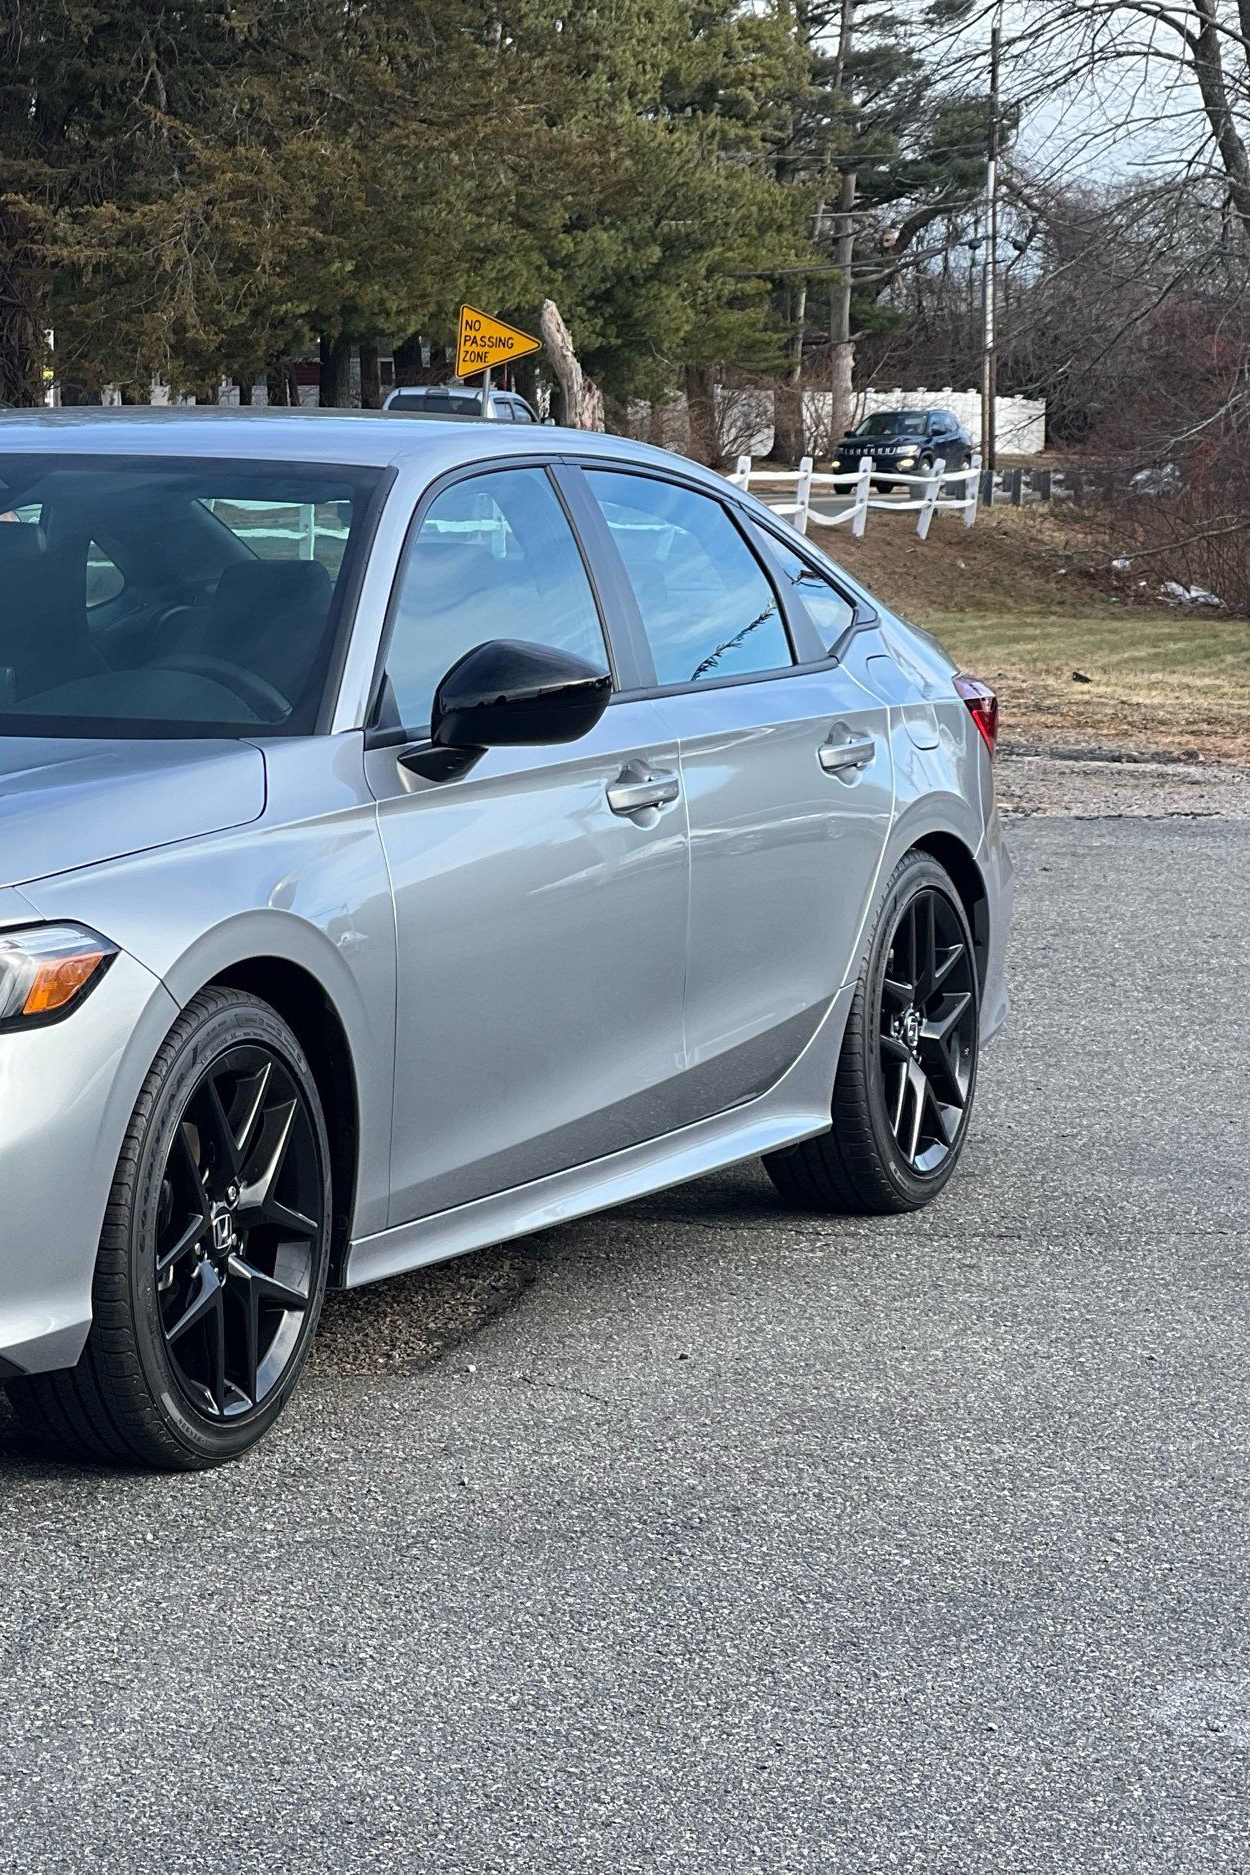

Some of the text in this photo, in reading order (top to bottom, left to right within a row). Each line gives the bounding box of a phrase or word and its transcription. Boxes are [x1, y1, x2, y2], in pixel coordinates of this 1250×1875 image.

[465, 319, 481, 332] NO
[463, 335, 514, 349] PASSING
[462, 350, 490, 363] ZONE
